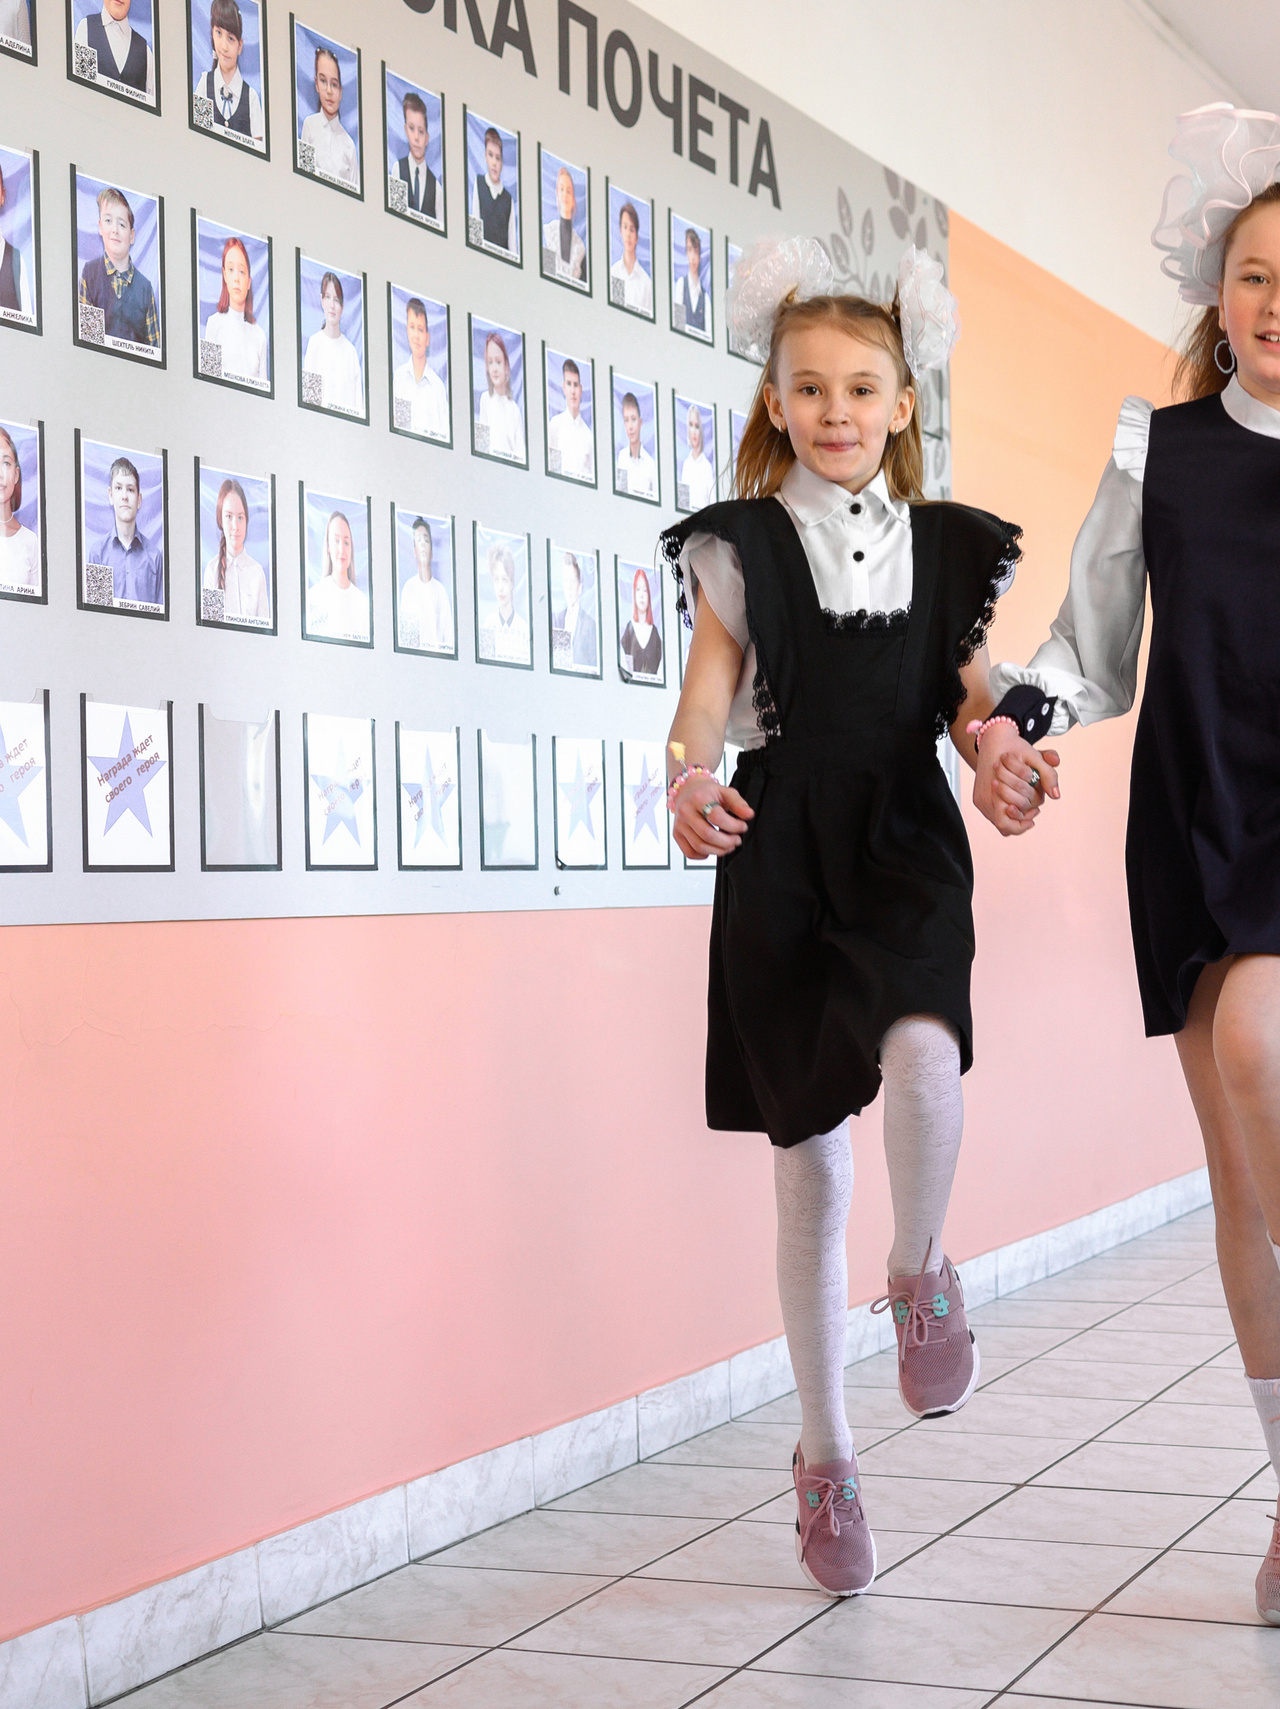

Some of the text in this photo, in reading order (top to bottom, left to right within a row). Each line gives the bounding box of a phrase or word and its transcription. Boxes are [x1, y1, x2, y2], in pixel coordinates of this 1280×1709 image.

[5, 37, 31, 54] АДЕЛИНА
[125, 87, 147, 102] ФИЛИПП
[558, 0, 782, 210] ПОЧЕТА
[3, 310, 33, 323] АНЖЕЛИКА
[136, 346, 154, 355] НИКИТА
[17, 586, 35, 595] АРИНА
[139, 603, 160, 612] САВЕЛИЙ
[4, 738, 28, 764] ждет
[97, 735, 153, 786] Награда ждет
[10, 757, 36, 783] героя
[105, 752, 160, 803] своего героя
